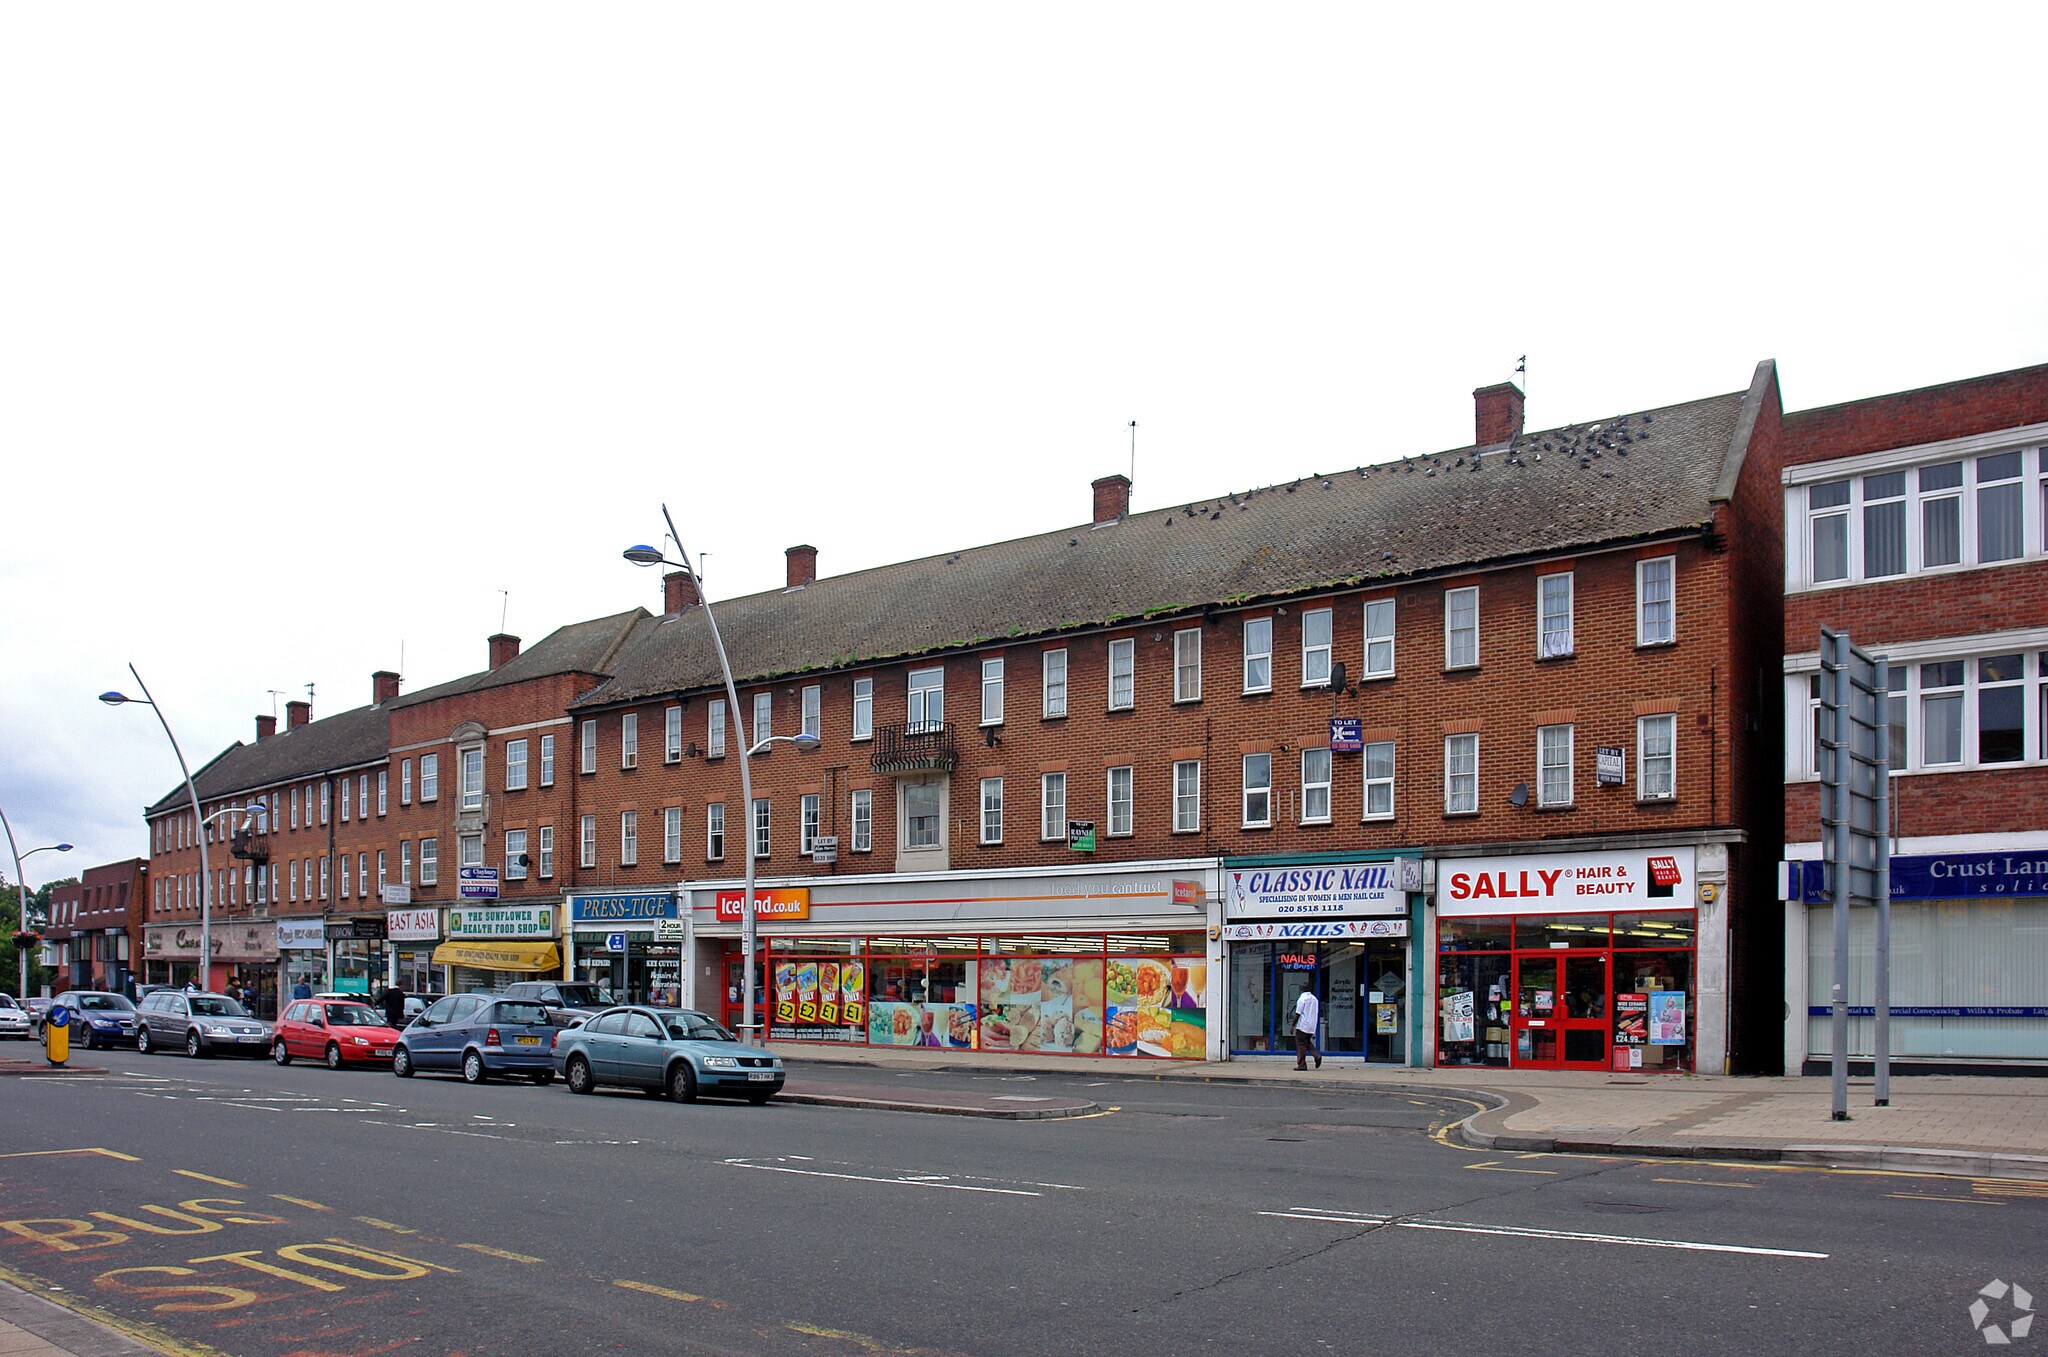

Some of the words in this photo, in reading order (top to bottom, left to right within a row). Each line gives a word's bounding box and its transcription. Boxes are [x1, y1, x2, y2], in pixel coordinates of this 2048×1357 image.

[1651, 859, 1675, 869] SALLY
[1930, 860, 1995, 878] Crust
[2003, 858, 2048, 875] Lan
[1576, 867, 1611, 879] HAIR
[1616, 866, 1628, 877] &
[1249, 869, 1336, 894] CLASSIC
[1340, 867, 1395, 890] NAIL
[1051, 881, 1080, 896] food
[1174, 886, 1196, 899] Iceland
[1576, 882, 1635, 895] BEAUTY
[1259, 895, 1298, 903] SPECIALISING
[1308, 893, 1331, 901] WOMEN
[1353, 892, 1368, 900] NAIL
[582, 897, 667, 917] PRESS-TIGE
[721, 896, 801, 914] Icelnd.co.uk
[1278, 905, 1294, 913] 020
[1322, 904, 1344, 912] 1118
[390, 913, 411, 930] EAST
[414, 912, 436, 930] ASIA
[468, 912, 482, 921] THE
[485, 911, 532, 921] SUNFLOWER
[463, 924, 492, 933] HEALTH
[495, 924, 515, 933] FOOD
[517, 923, 538, 934] SHOP
[661, 920, 667, 929] 2
[1278, 923, 1346, 937] NAILS
[1280, 954, 1316, 964] NAILS
[778, 991, 793, 1002] ONLY
[799, 991, 814, 1002] ONLY
[821, 992, 836, 1002] ONLY
[844, 992, 860, 1003] ONLY
[1452, 993, 1471, 1002] RUSK
[778, 1003, 793, 1019] £2
[799, 1003, 815, 1019] £2
[821, 1004, 836, 1020] £1
[845, 1005, 859, 1020] £1
[1912, 1007, 1960, 1016] Conveyancing
[1967, 1006, 1986, 1014] Wills
[1997, 1006, 2024, 1014] Probate
[0, 1198, 289, 1251] BUS
